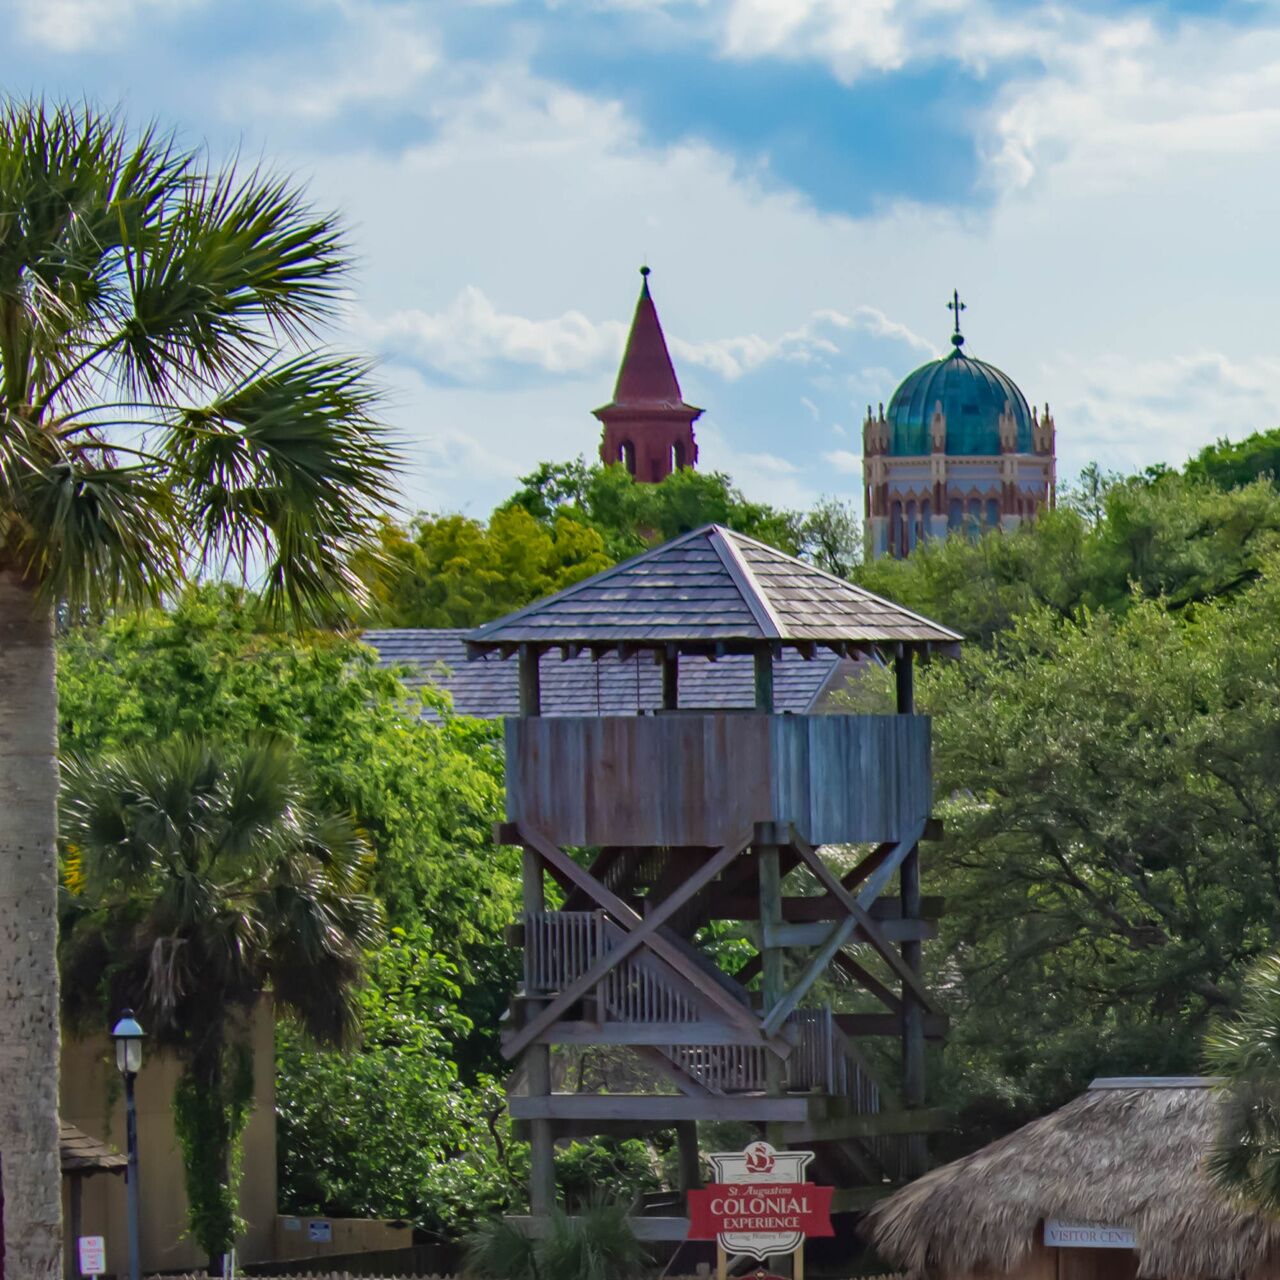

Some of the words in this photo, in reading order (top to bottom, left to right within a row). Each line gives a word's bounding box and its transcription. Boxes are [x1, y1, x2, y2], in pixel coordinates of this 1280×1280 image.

[728, 1186, 741, 1196] St.
[743, 1185, 793, 1198] Augustine
[710, 1197, 813, 1216] COLONIAL
[723, 1216, 801, 1230] EXPERIENCE
[1050, 1230, 1097, 1242] VISITOR
